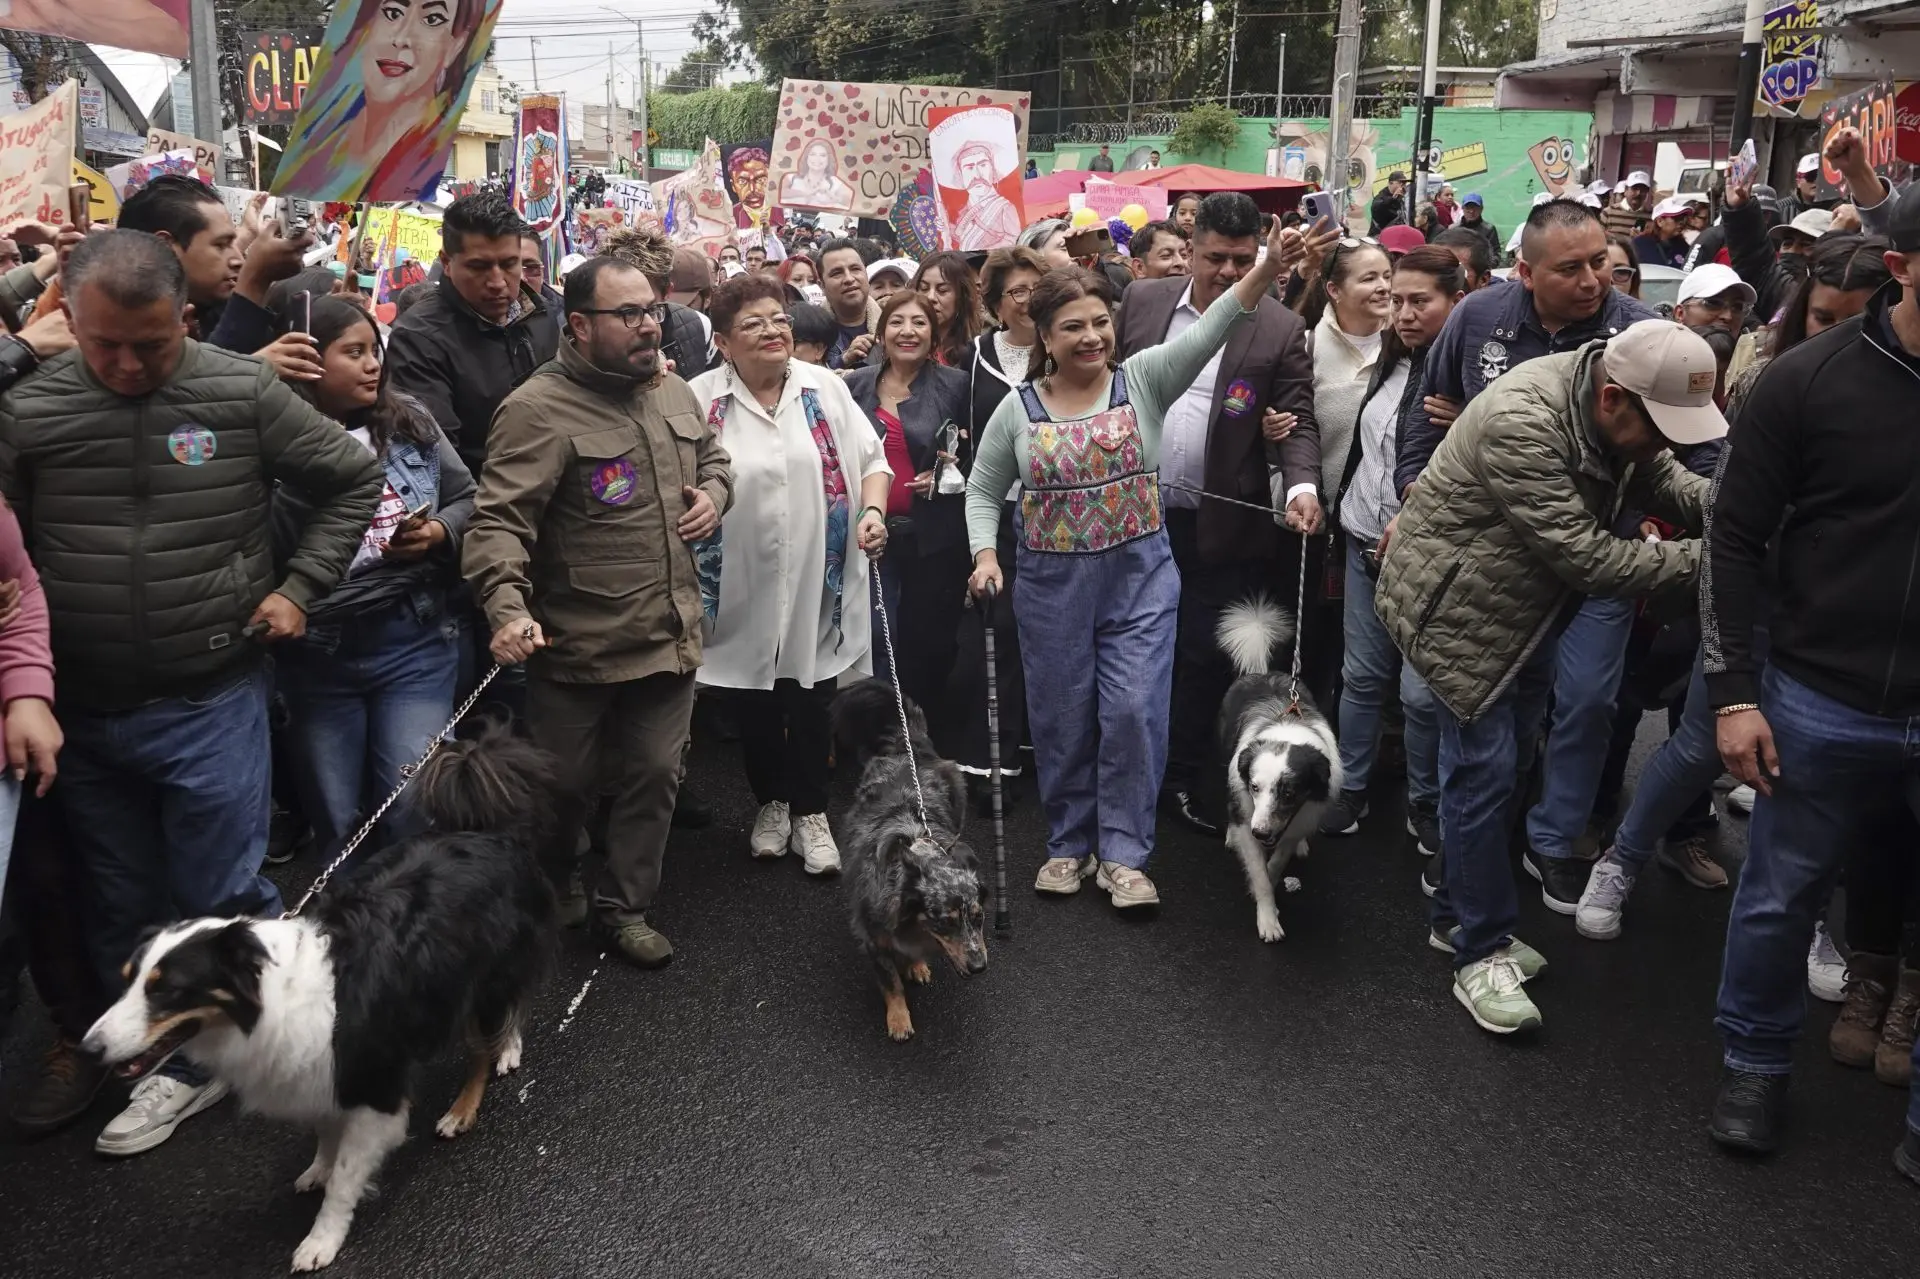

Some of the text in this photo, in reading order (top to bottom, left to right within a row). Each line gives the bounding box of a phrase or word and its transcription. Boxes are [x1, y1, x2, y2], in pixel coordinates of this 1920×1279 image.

[1762, 2, 1819, 63] Takis
[1761, 56, 1821, 106] POP
[660, 151, 690, 167] ESCUELA
[37, 192, 63, 225] de
